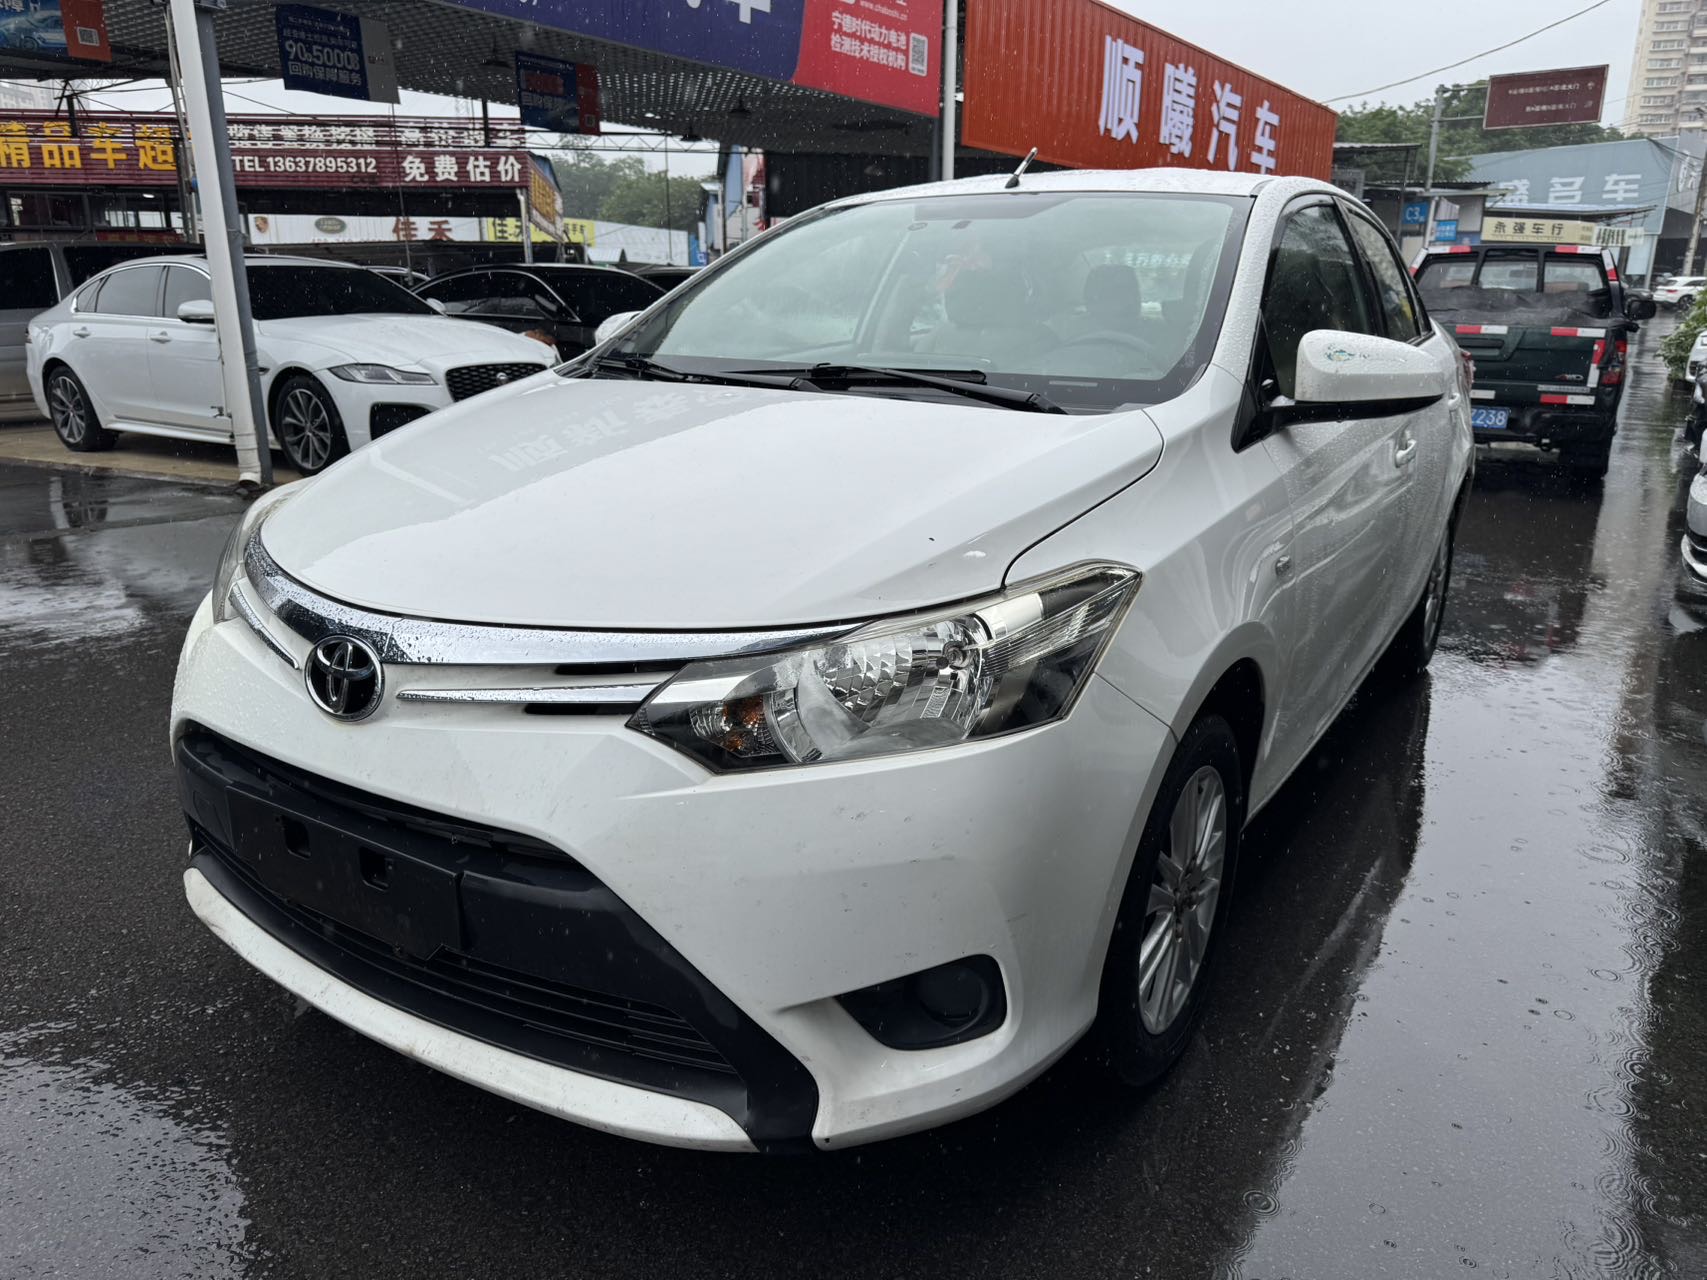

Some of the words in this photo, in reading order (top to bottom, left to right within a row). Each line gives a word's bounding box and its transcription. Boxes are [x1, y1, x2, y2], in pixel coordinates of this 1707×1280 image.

[831, 10, 907, 50] 宁德时代动力电池
[831, 31, 906, 71] 检测技术授权机构
[266, 157, 377, 173] 13637895312
[402, 154, 522, 182] 免费估价
